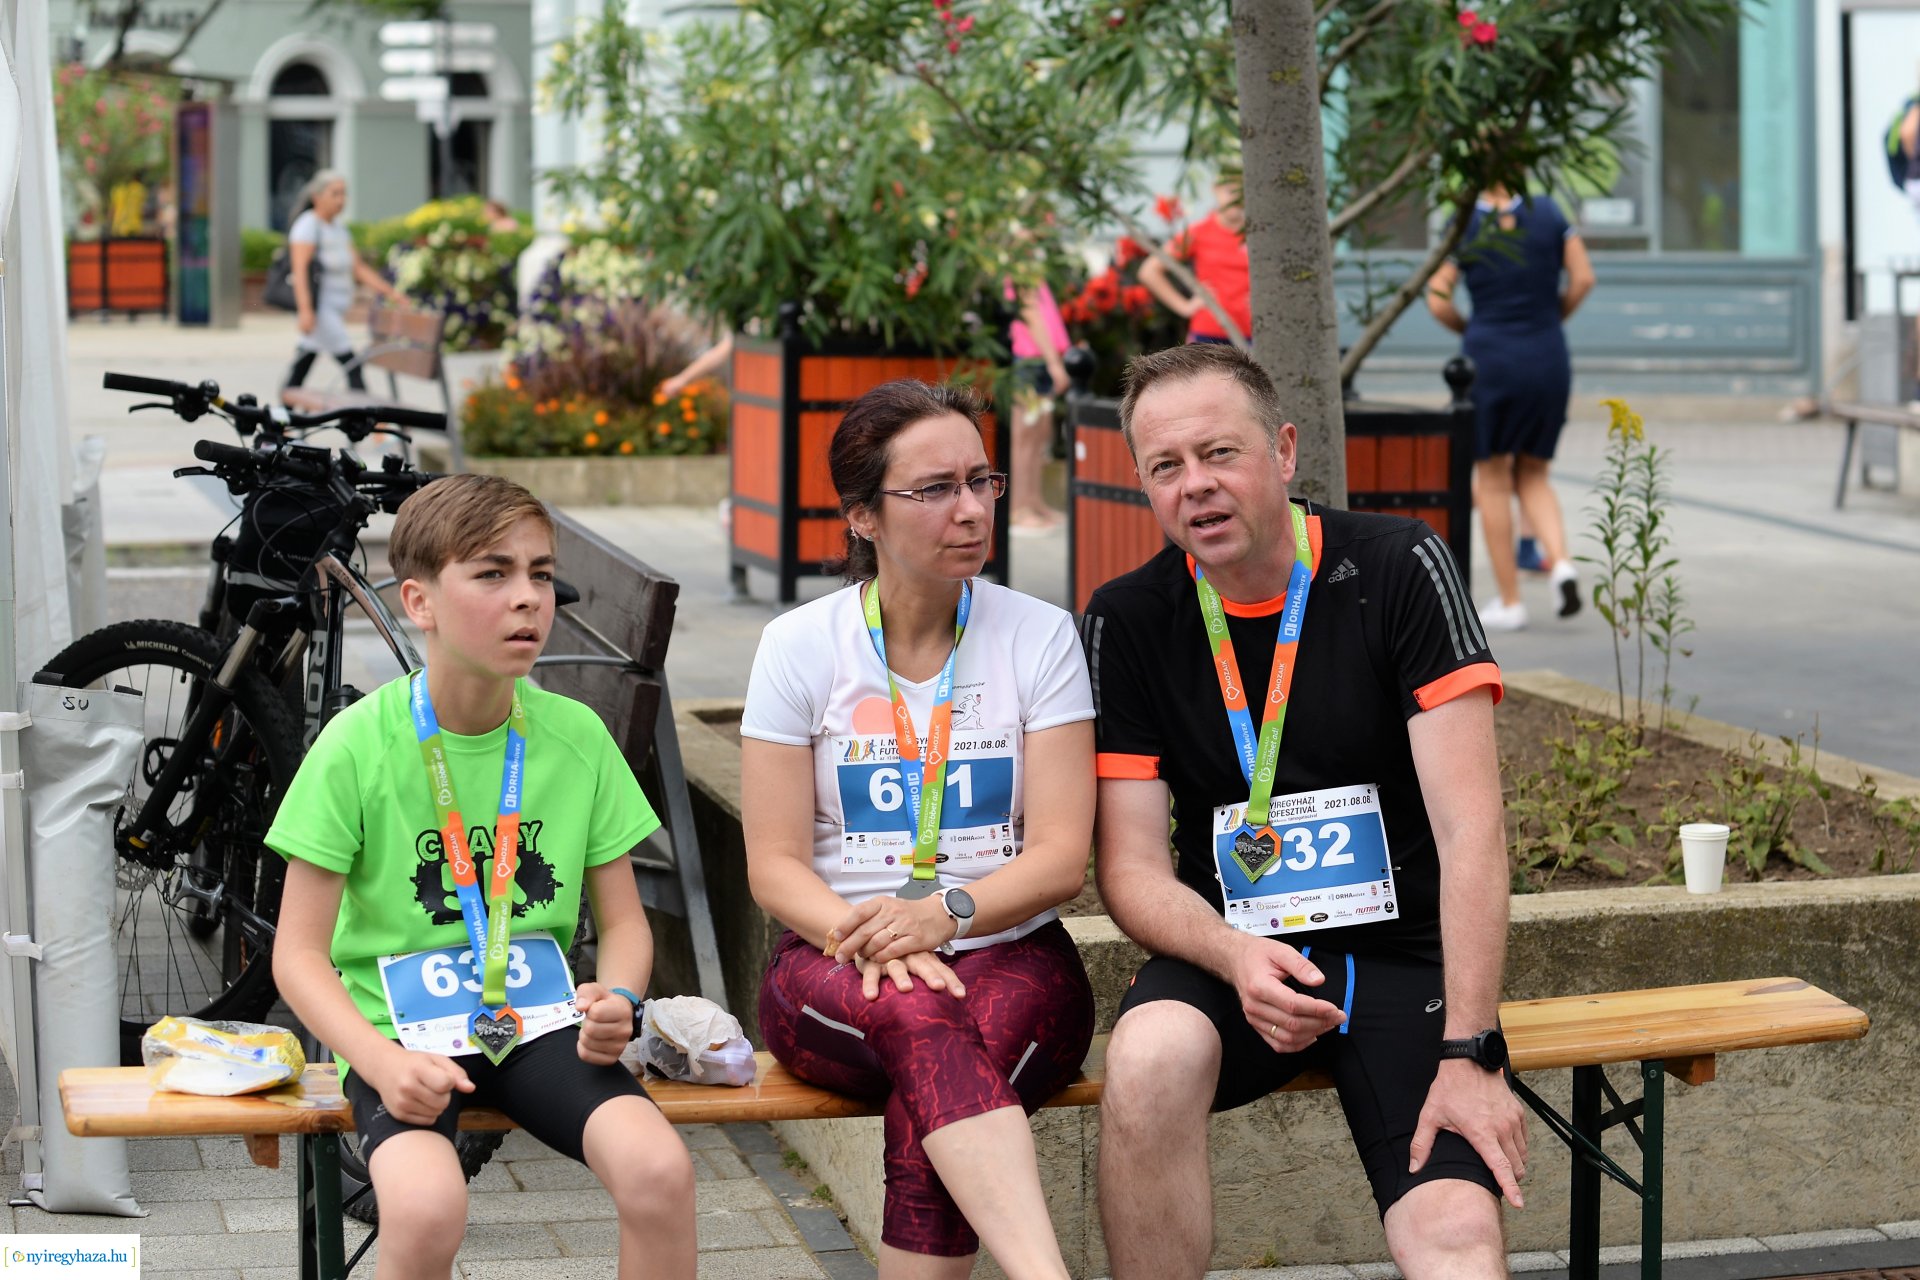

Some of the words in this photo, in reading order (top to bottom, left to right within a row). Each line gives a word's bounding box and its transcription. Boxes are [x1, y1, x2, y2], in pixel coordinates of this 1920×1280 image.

[1328, 567, 1360, 584] adidas
[136, 641, 179, 653] MICHELIN
[1221, 659, 1231, 687] MOZAIK
[1275, 663, 1285, 690] MOZAIK
[933, 724, 941, 752] MOZAIK
[953, 739, 1009, 751] 2021.08.08.
[869, 763, 973, 812] 61
[928, 803, 937, 828] Többet
[1269, 796, 1315, 810] YÍREGYHÁZI
[1324, 795, 1373, 810] 2021.08.08.
[416, 820, 544, 862] CAY
[1262, 822, 1355, 876] 32
